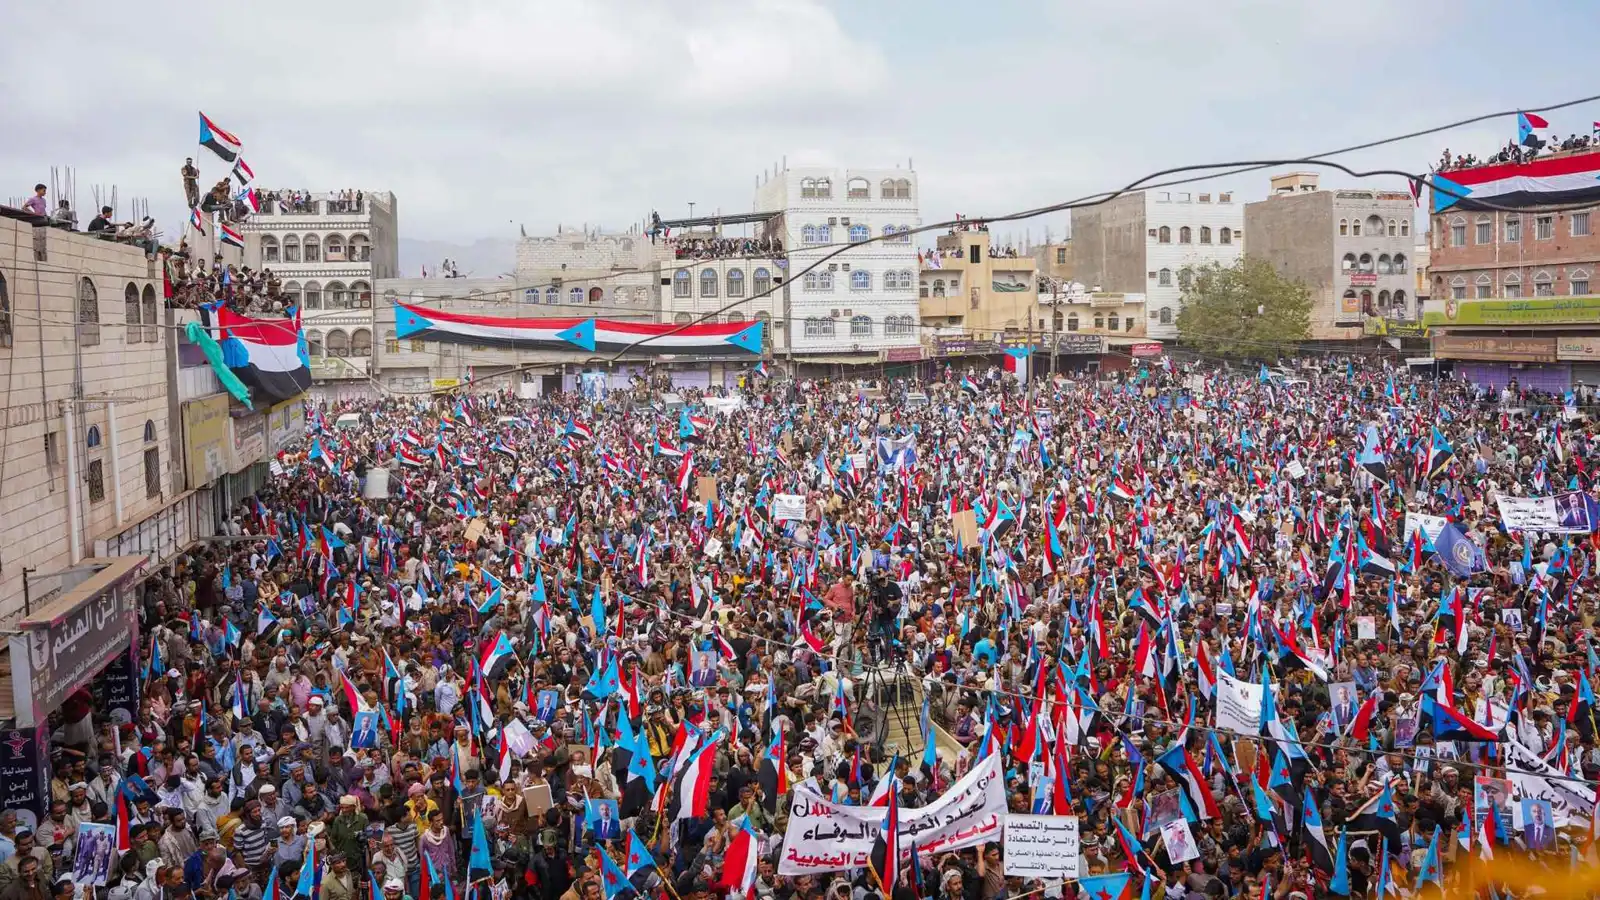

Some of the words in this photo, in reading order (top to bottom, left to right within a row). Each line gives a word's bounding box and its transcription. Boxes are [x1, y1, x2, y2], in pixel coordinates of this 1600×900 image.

[52, 604, 93, 671] الهيثم
[2, 767, 32, 777] صيدلية
[977, 770, 996, 790] من
[4, 792, 34, 808] الهيثم
[803, 822, 878, 843] والوفاء
[898, 815, 941, 836] العه
[1008, 820, 1043, 832] التصعيد
[1043, 821, 1075, 833] نحو
[1008, 834, 1037, 843] لاستعادة
[1037, 836, 1075, 846] والزحف
[787, 848, 851, 868] الجنوبية
